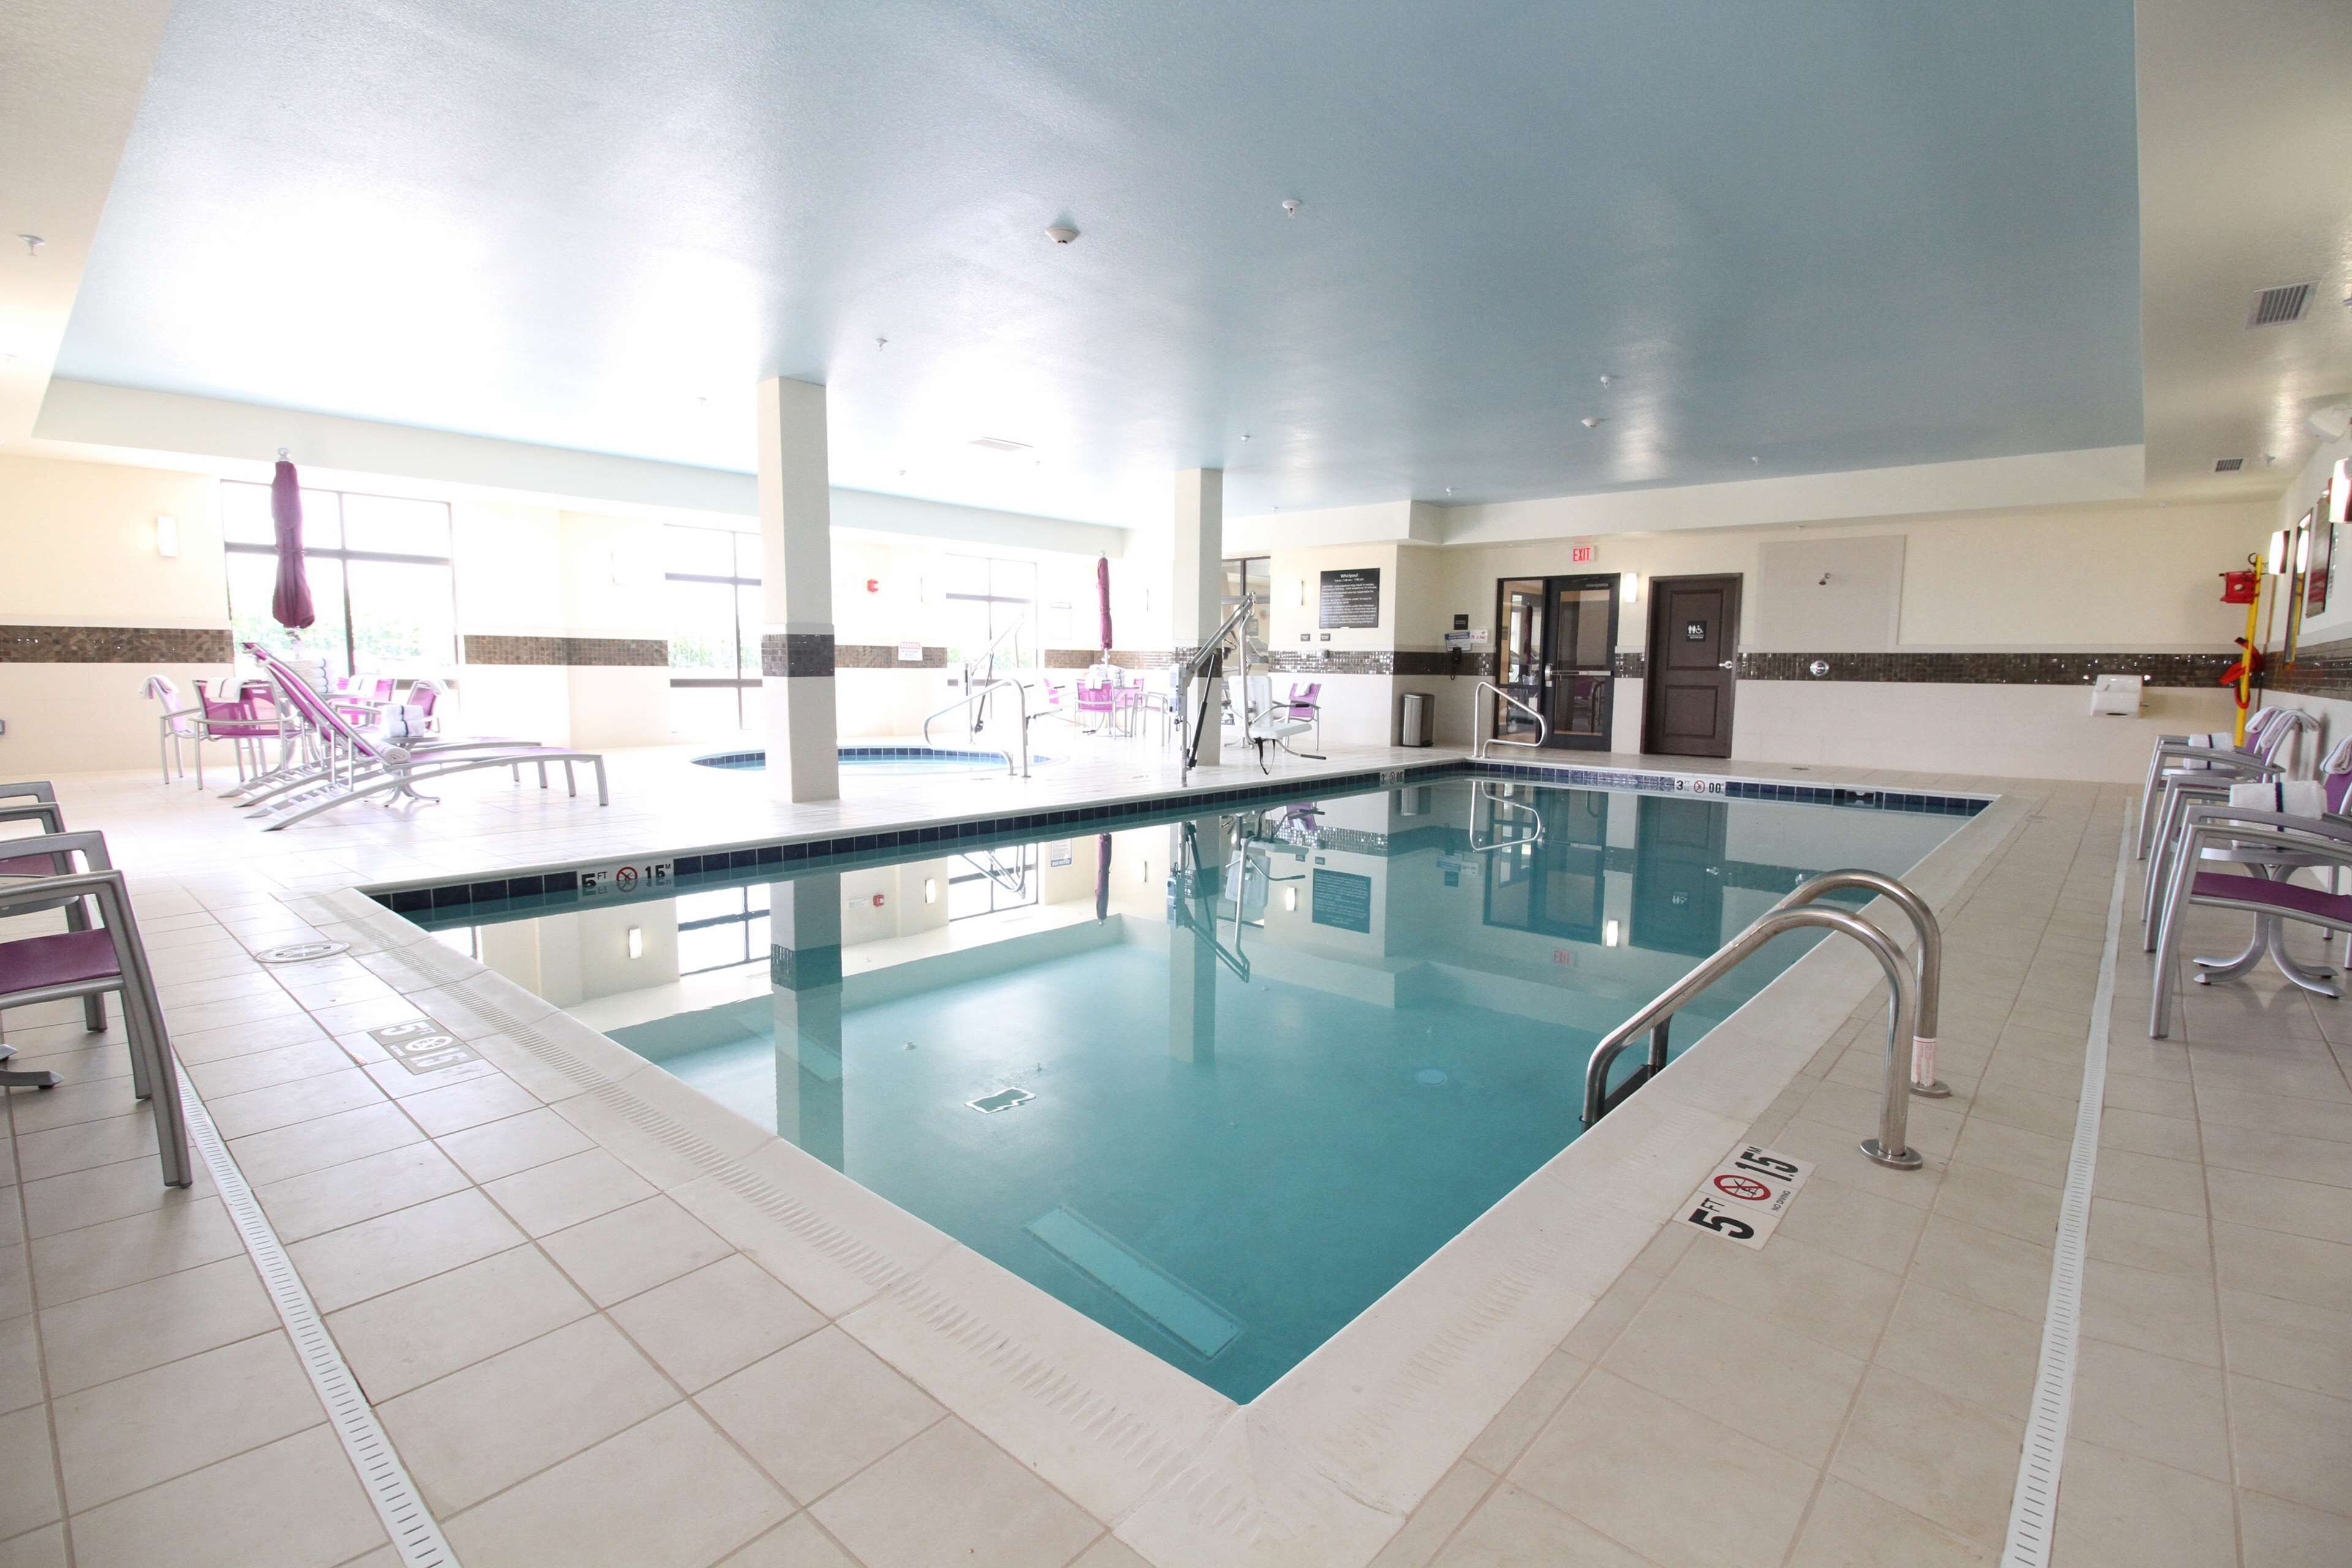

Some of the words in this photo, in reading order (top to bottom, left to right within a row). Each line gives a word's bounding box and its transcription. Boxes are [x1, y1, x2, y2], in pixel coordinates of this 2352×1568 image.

[1573, 548, 1590, 562] EXIT
[581, 873, 597, 888] 5
[1746, 1145, 1763, 1155] M
[1735, 1151, 1799, 1182] 1.5
[1700, 1197, 1725, 1213] FT
[1776, 1190, 1792, 1205] DIVING
[1771, 1203, 1782, 1212] NO
[1688, 1208, 1754, 1240] 5
